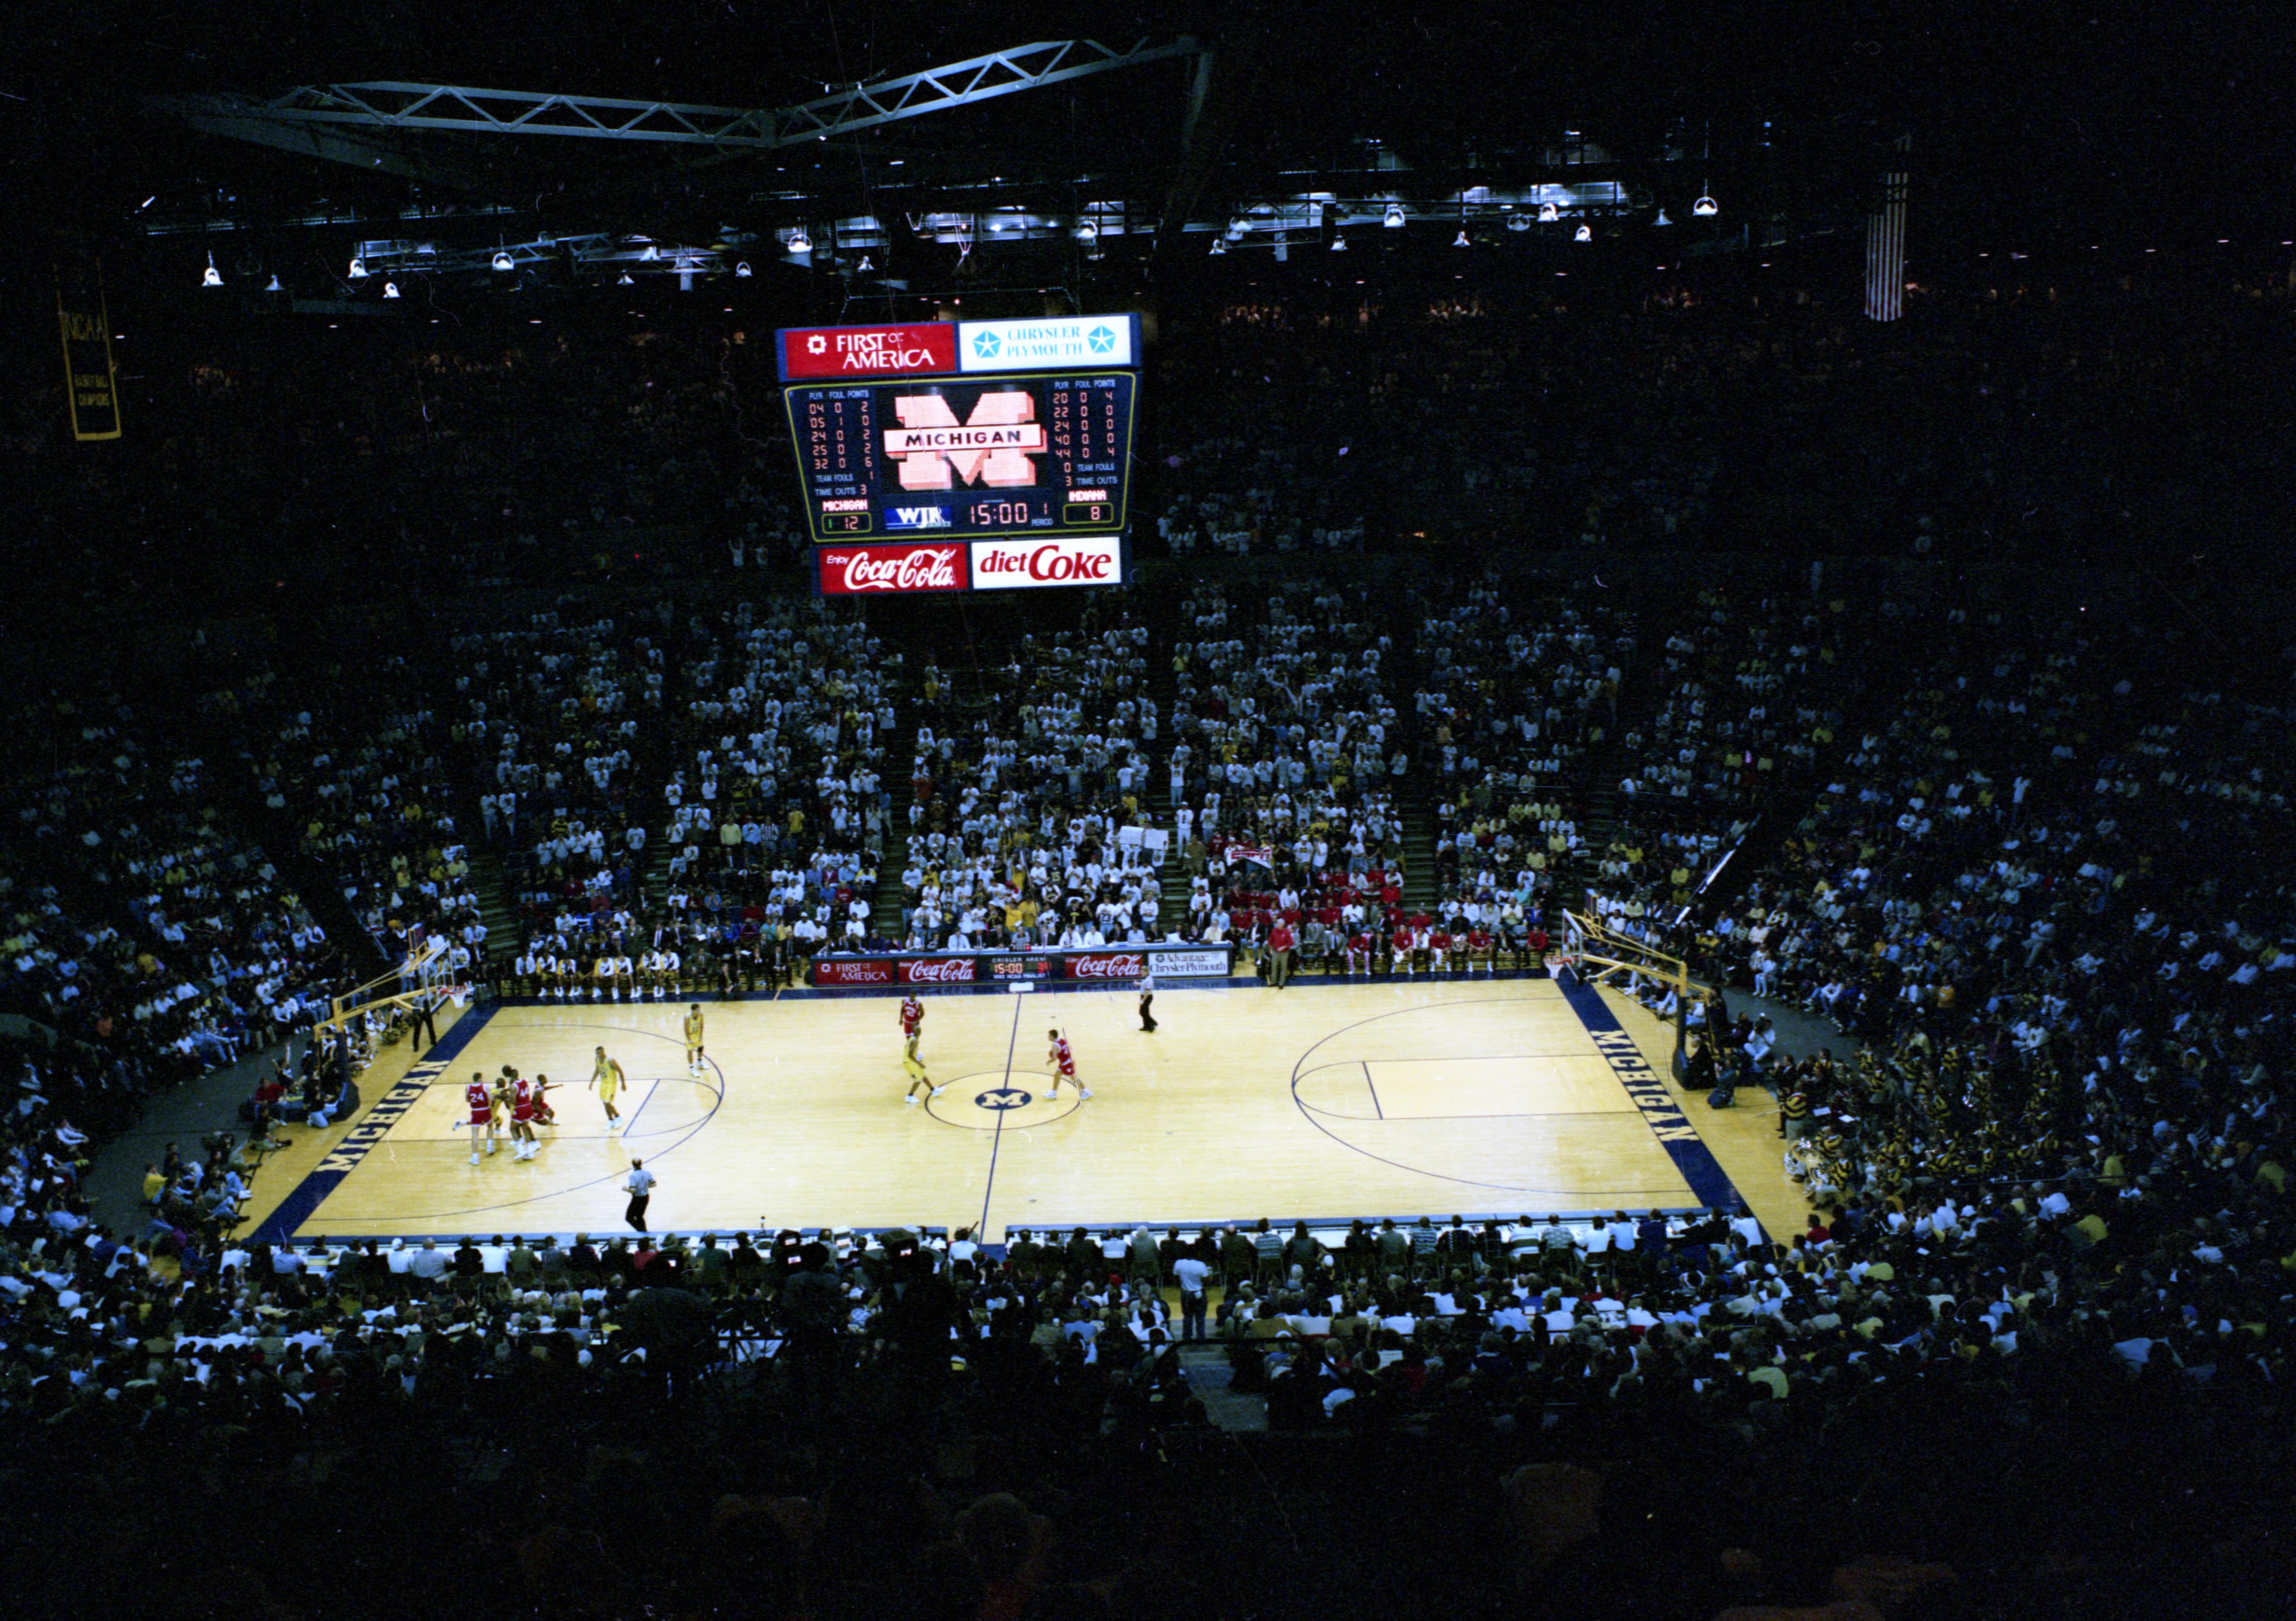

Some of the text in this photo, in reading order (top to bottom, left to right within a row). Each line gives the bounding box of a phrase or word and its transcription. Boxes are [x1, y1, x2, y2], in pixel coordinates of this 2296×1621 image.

[1008, 326, 1080, 342] CHRYSLER
[836, 332, 905, 354] FIRST OF
[1007, 342, 1083, 358] PLYMOUTH
[842, 348, 935, 370] AMERICA
[1075, 380, 1091, 388] FOUL
[1094, 379, 1116, 388] POINTS
[829, 391, 846, 399] FOUL
[847, 390, 869, 399] POINTS
[1053, 391, 1113, 404] 20 0 4
[809, 401, 868, 414] 04 0 2
[1054, 404, 1113, 418] 22 0 0
[810, 415, 869, 428] 05 1 0
[1054, 418, 1114, 432] 24 0 0
[811, 429, 870, 442] 24 0 2
[905, 430, 1021, 448] MICHIGAN
[1054, 432, 1114, 445] 40 0 0
[813, 443, 871, 455] 25 0 2
[1055, 447, 1115, 458] 44 0 4
[814, 457, 872, 469] 32 0 6
[1063, 462, 1115, 473] 0 TEAM FOULS
[834, 474, 854, 482] FOULS
[870, 471, 874, 480] 1
[1065, 476, 1118, 486] 3 TIME OUTS
[835, 487, 857, 496] OUTS
[860, 484, 867, 495] 3
[1068, 490, 1107, 502] INDIANA
[822, 499, 868, 511] MICHIGAN
[1043, 502, 1048, 515] 1
[896, 506, 945, 528] WJR
[970, 502, 1028, 525] 15:00
[1090, 506, 1100, 521] 8
[845, 516, 858, 530] 12
[1031, 518, 1054, 527] PERIOD
[826, 549, 957, 589] Enjoy Coca-Cola
[980, 545, 1112, 581] diet Coke
[1167, 953, 1210, 964] Advantage
[836, 963, 862, 973] FIRST
[909, 959, 975, 982] Coca-Cola
[994, 963, 1023, 974] 15:00
[1076, 954, 1142, 977] Coca-Cola
[1149, 961, 1226, 975] Chrysler-Plymouth
[839, 971, 888, 981] AMERICA
[1588, 1030, 1701, 1141] MICHIGAN
[469, 1093, 484, 1103] 24
[982, 1092, 1025, 1107] M
[317, 1060, 451, 1172] MICHIGAN
